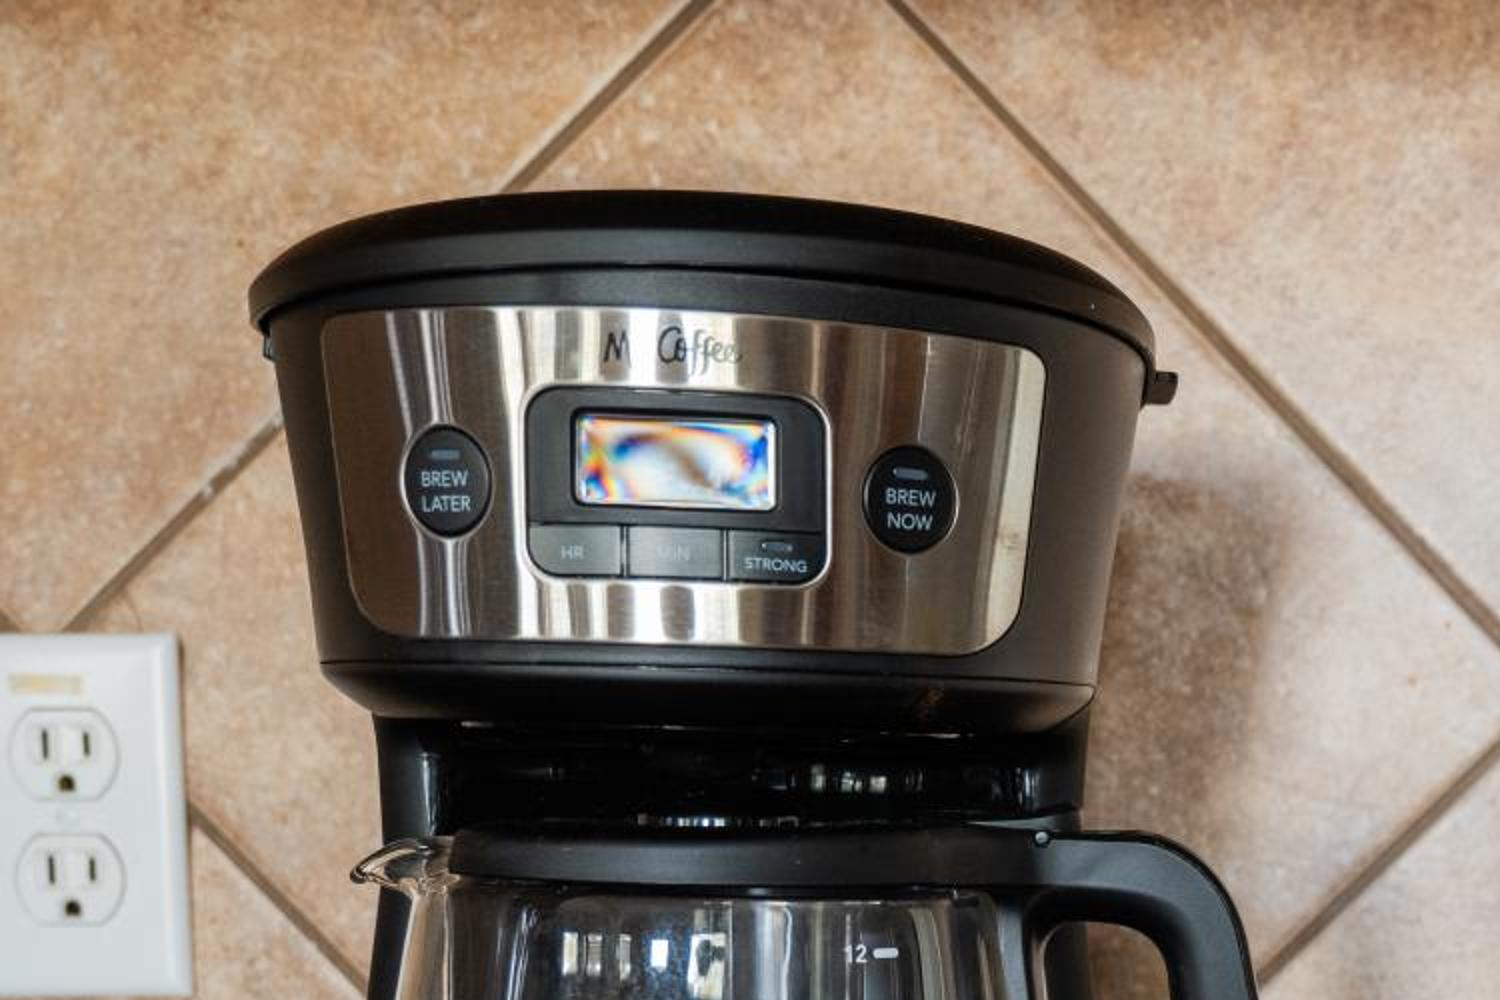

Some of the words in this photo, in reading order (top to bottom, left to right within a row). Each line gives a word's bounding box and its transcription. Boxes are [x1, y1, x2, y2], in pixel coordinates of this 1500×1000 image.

[657, 325, 743, 376] Coffee
[421, 468, 469, 488] BREW
[421, 494, 472, 513] LATER
[885, 486, 937, 508] BREW
[887, 511, 933, 531] NOW
[560, 545, 583, 560] HR
[744, 557, 808, 573] STRONG
[844, 944, 867, 963] 12
